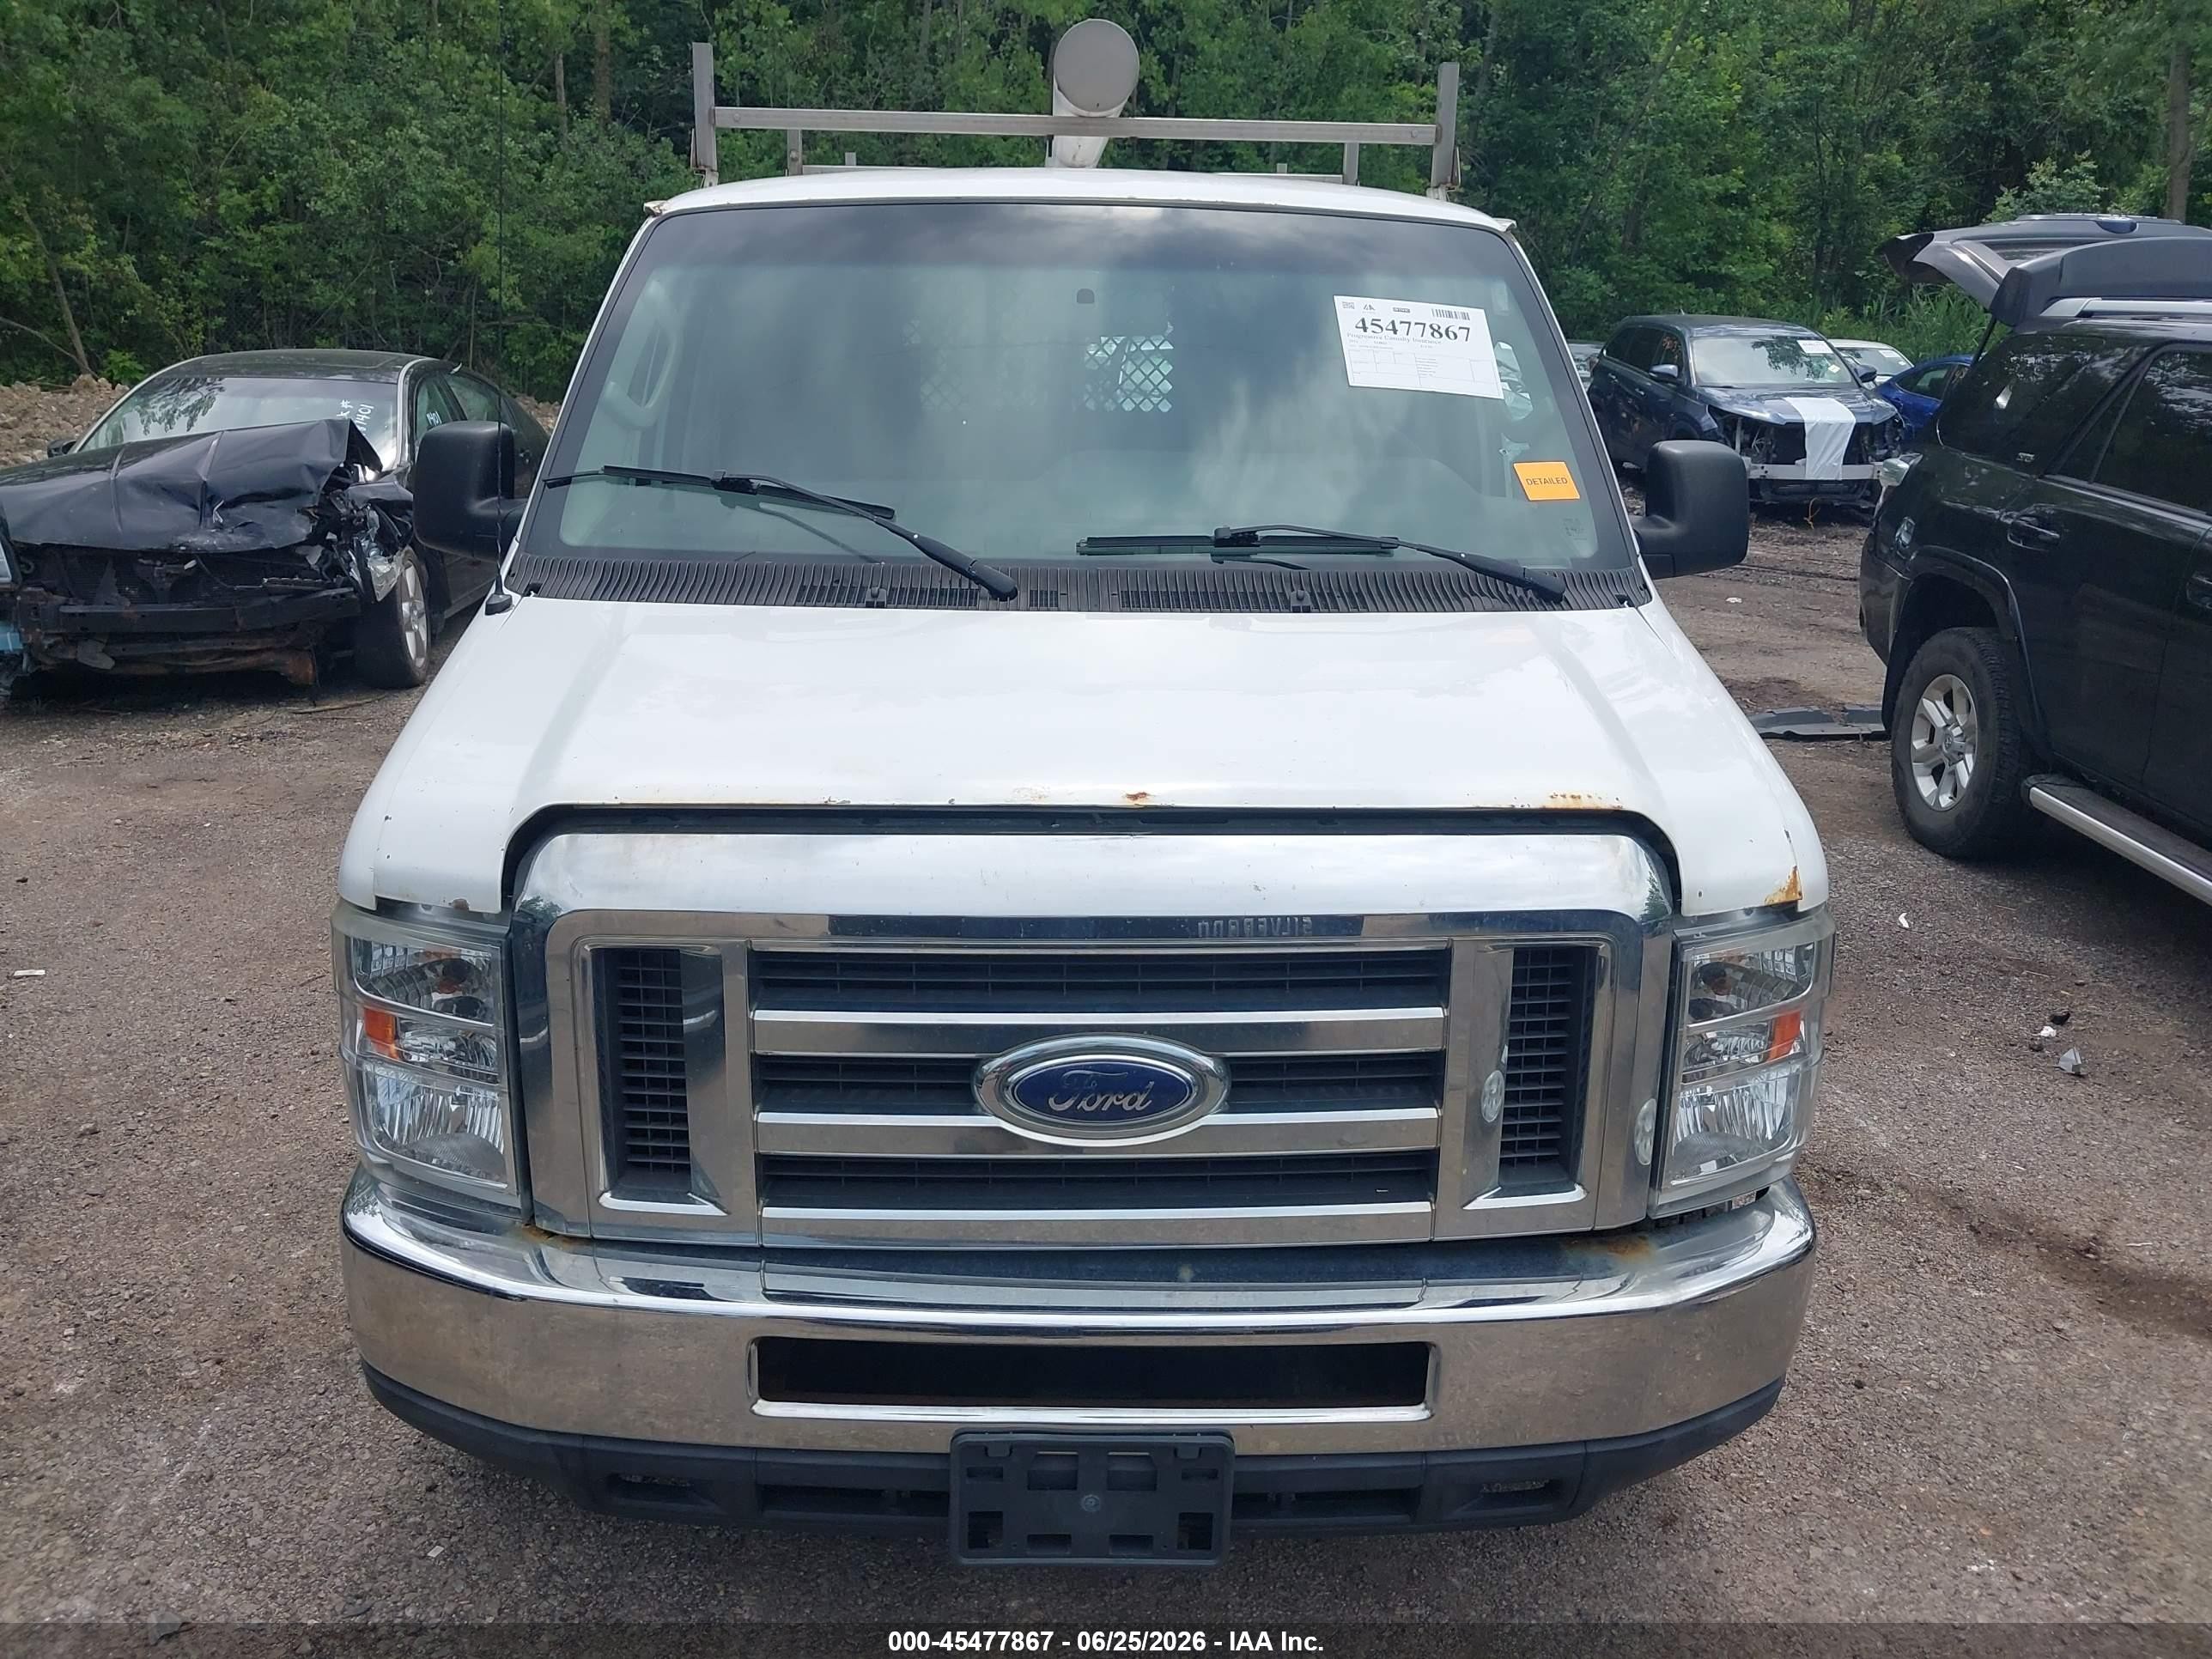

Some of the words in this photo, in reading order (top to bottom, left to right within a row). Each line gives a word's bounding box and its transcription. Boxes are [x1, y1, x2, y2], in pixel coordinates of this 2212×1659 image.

[1355, 317, 1470, 343] 45477867
[1525, 477, 1568, 486] DETAILED
[1047, 1069, 1155, 1111] Ford
